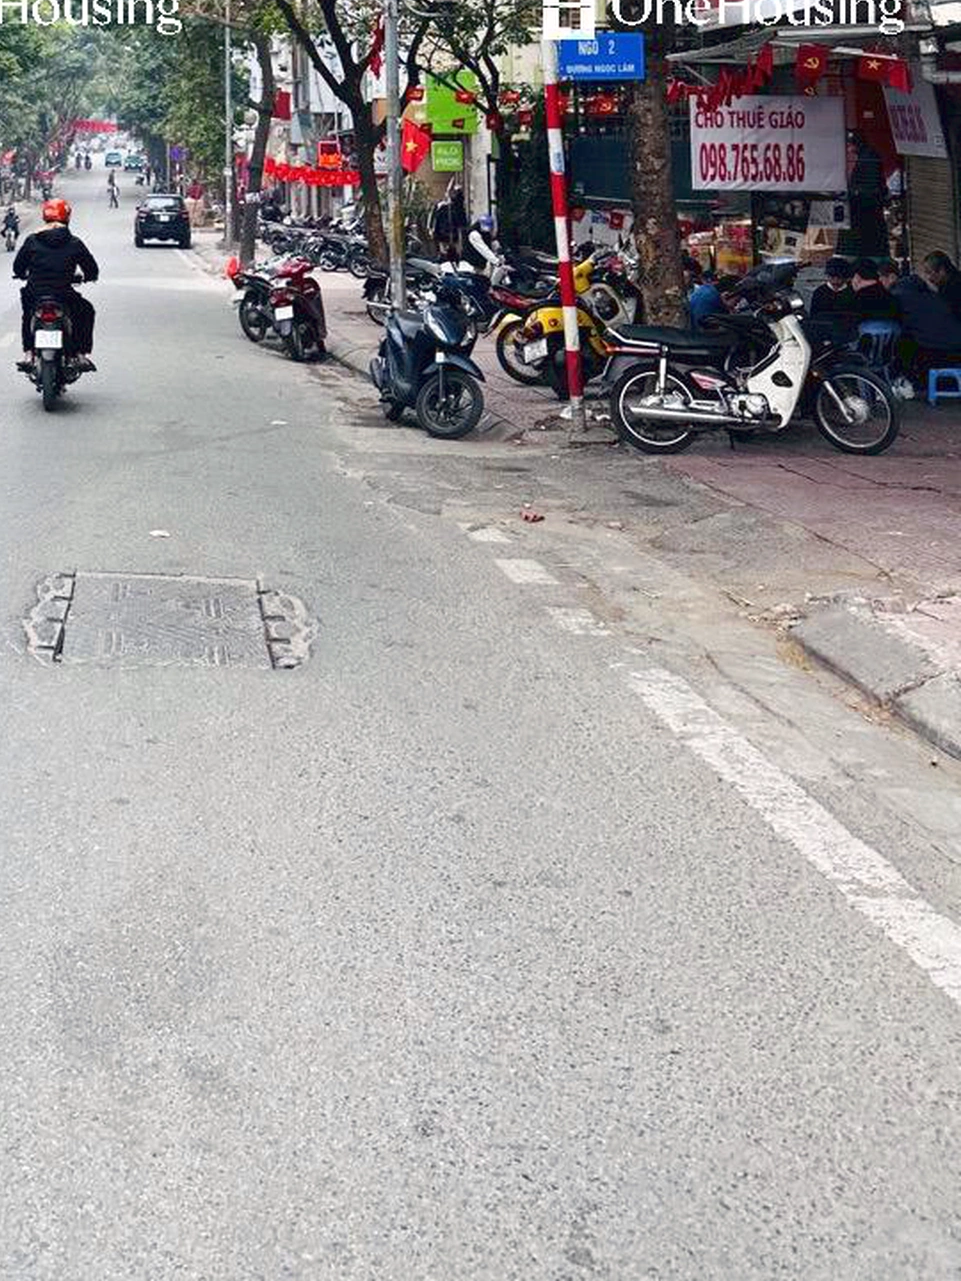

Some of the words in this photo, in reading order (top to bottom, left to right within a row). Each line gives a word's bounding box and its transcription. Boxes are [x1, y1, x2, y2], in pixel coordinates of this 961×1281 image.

[608, 39, 616, 55] 2
[695, 110, 724, 129] CHO
[728, 105, 766, 129] THUÊ
[768, 104, 805, 129] GIÁO
[699, 142, 806, 183] 098.765.68.86
